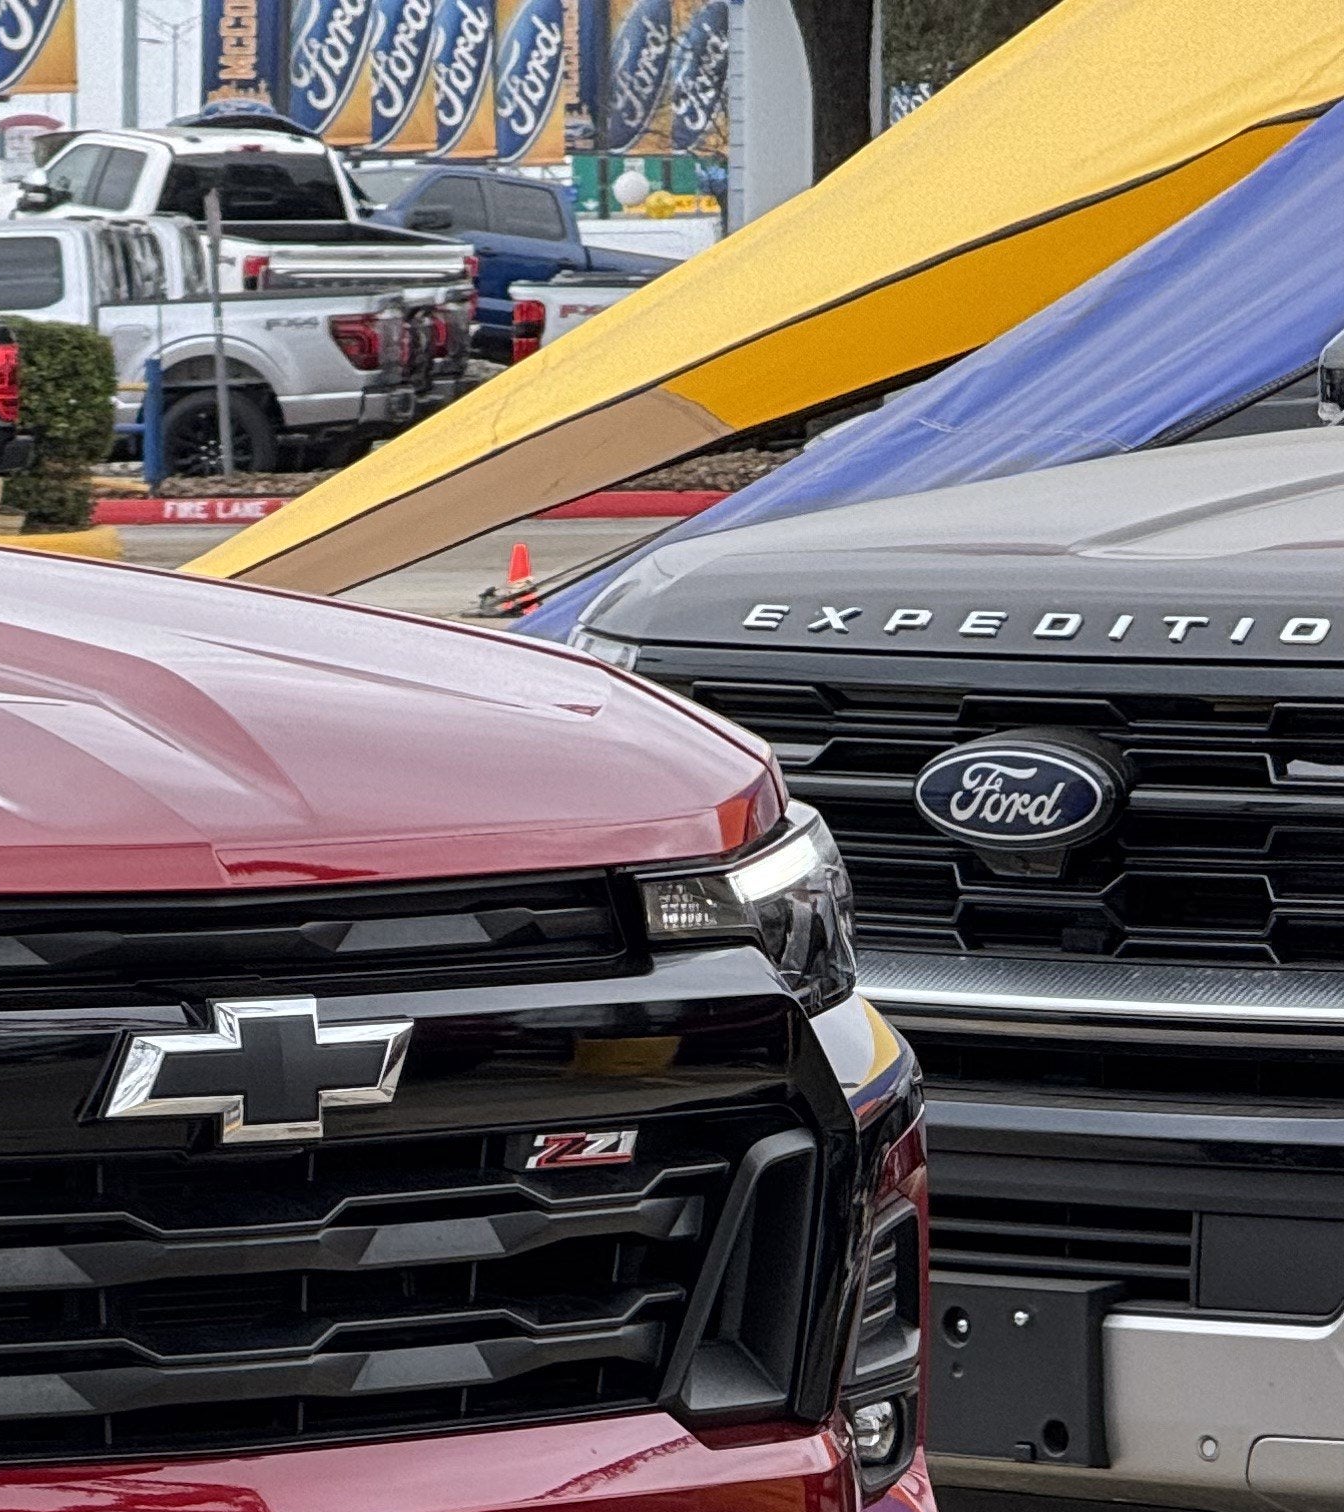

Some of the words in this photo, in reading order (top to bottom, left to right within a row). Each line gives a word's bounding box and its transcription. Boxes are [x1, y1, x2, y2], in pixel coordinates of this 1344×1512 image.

[433, 0, 490, 126] Ford
[497, 14, 561, 135] Ford
[163, 500, 207, 519] FIRE
[214, 500, 267, 519] LANE
[742, 603, 1332, 646] EXPEDITIO
[949, 760, 1064, 827] Ford
[525, 1129, 639, 1170] Z71
